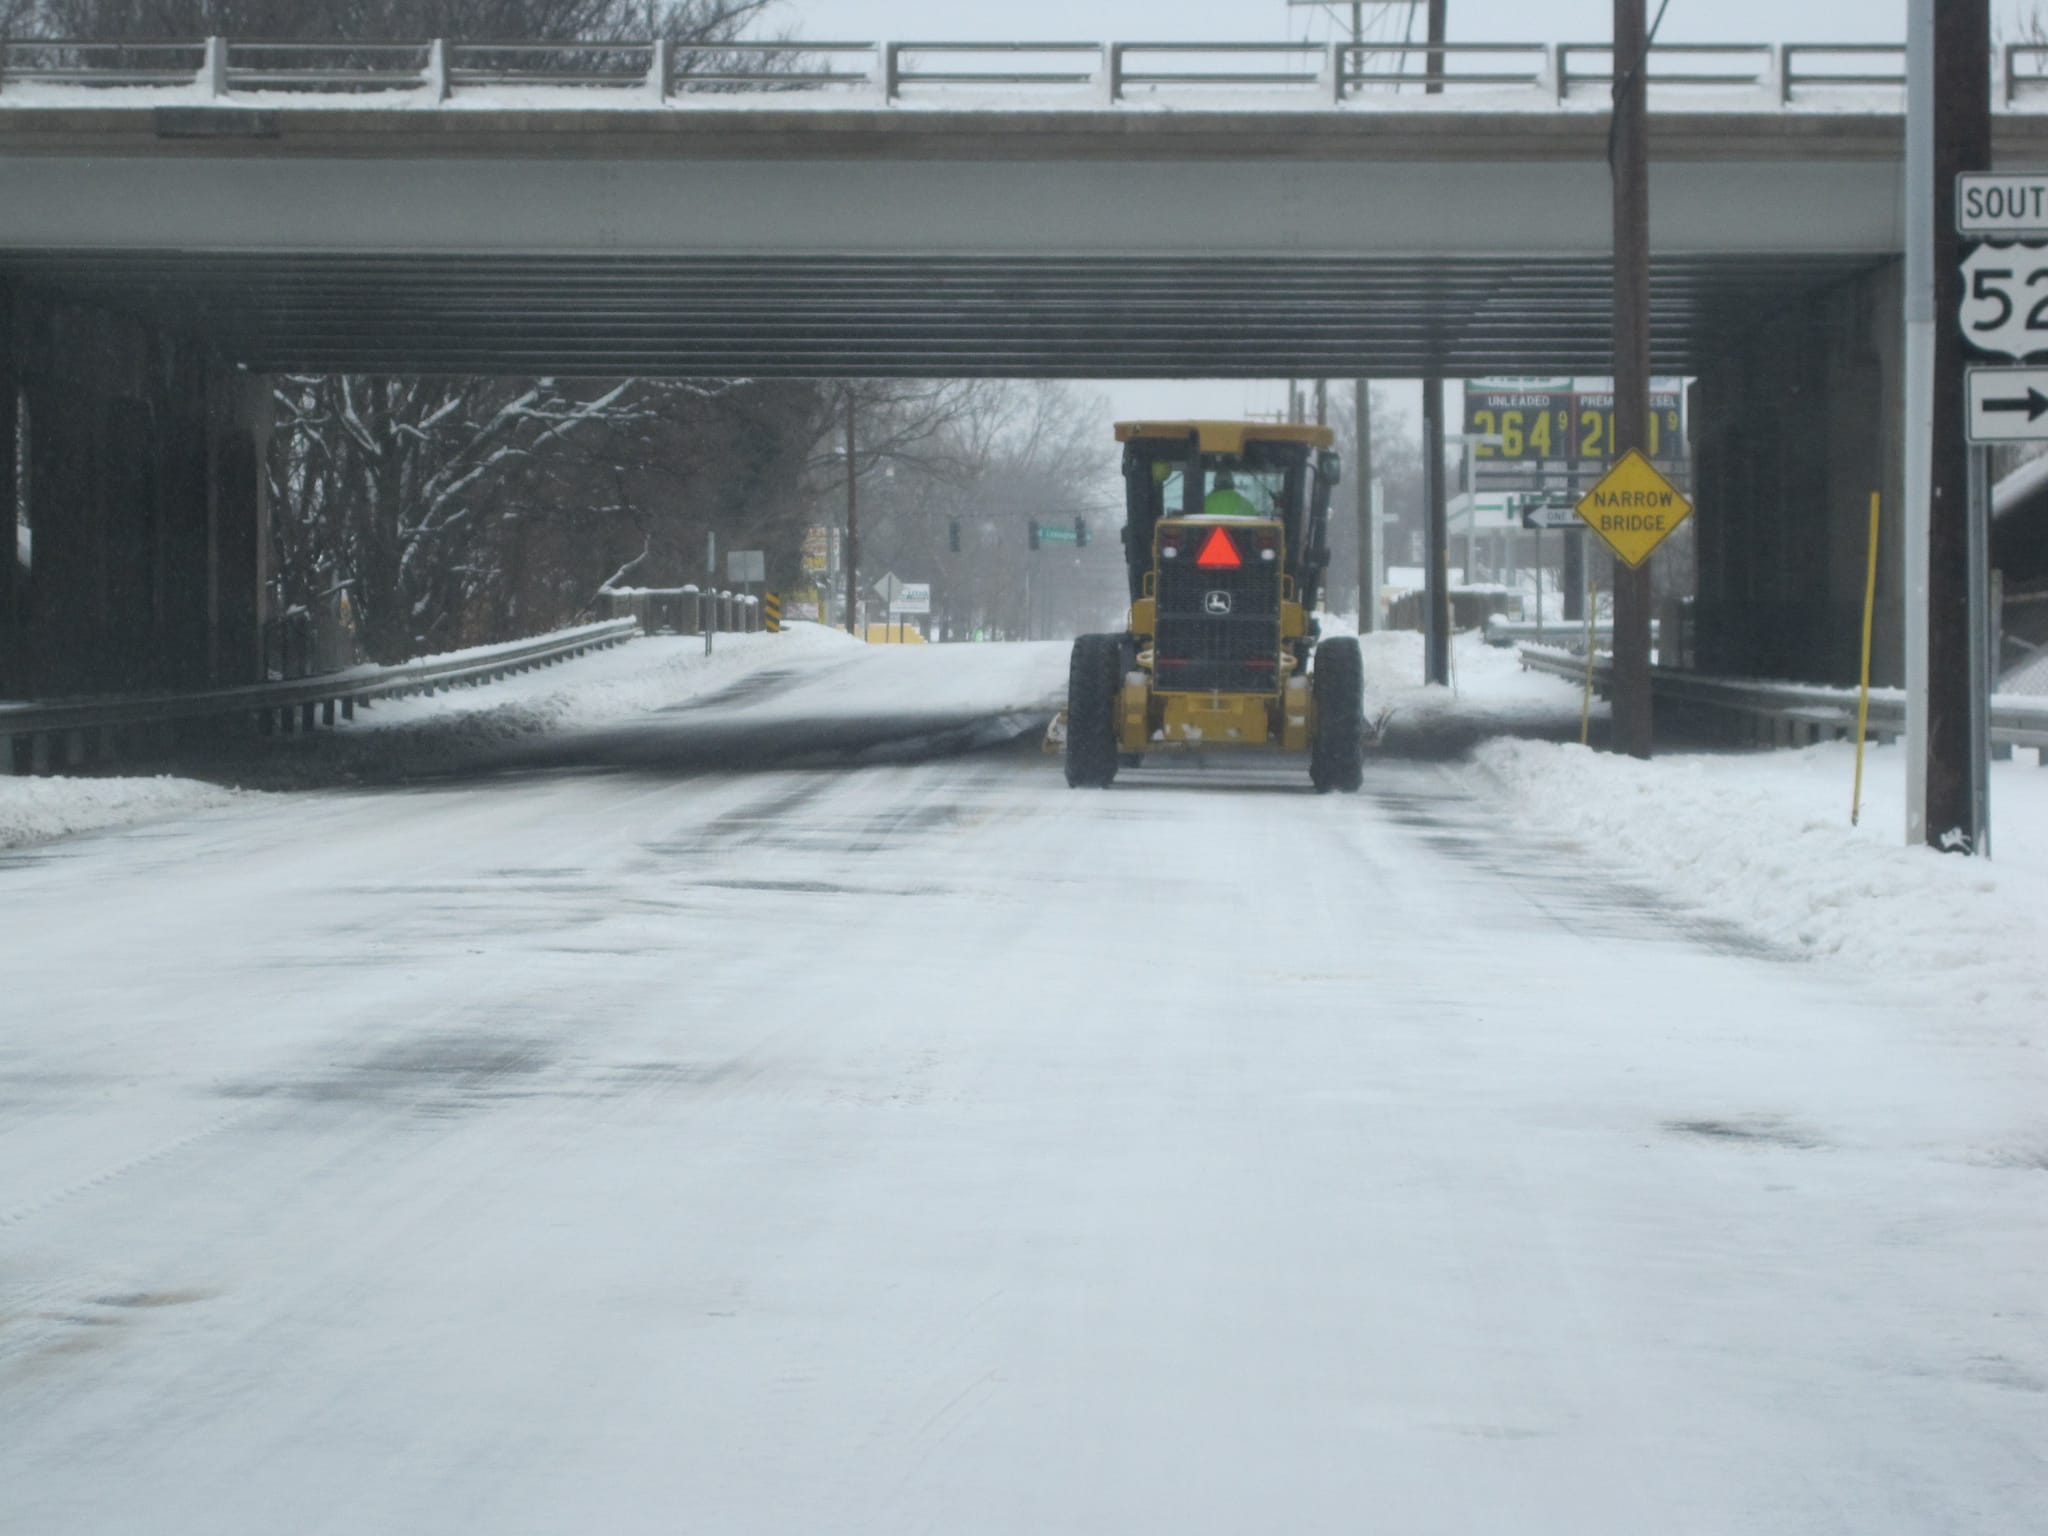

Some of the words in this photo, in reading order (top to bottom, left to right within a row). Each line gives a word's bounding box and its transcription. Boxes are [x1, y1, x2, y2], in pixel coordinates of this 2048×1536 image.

[1966, 187, 2047, 218] SOUT
[1972, 267, 2048, 332] 52
[1487, 395, 1550, 407] UNLEADED
[1580, 394, 1614, 407] PREM
[1649, 394, 1677, 407] ESEL
[1474, 410, 1551, 457] 264
[1594, 491, 1673, 507] NARROW
[1601, 515, 1666, 531] BRIDGE
